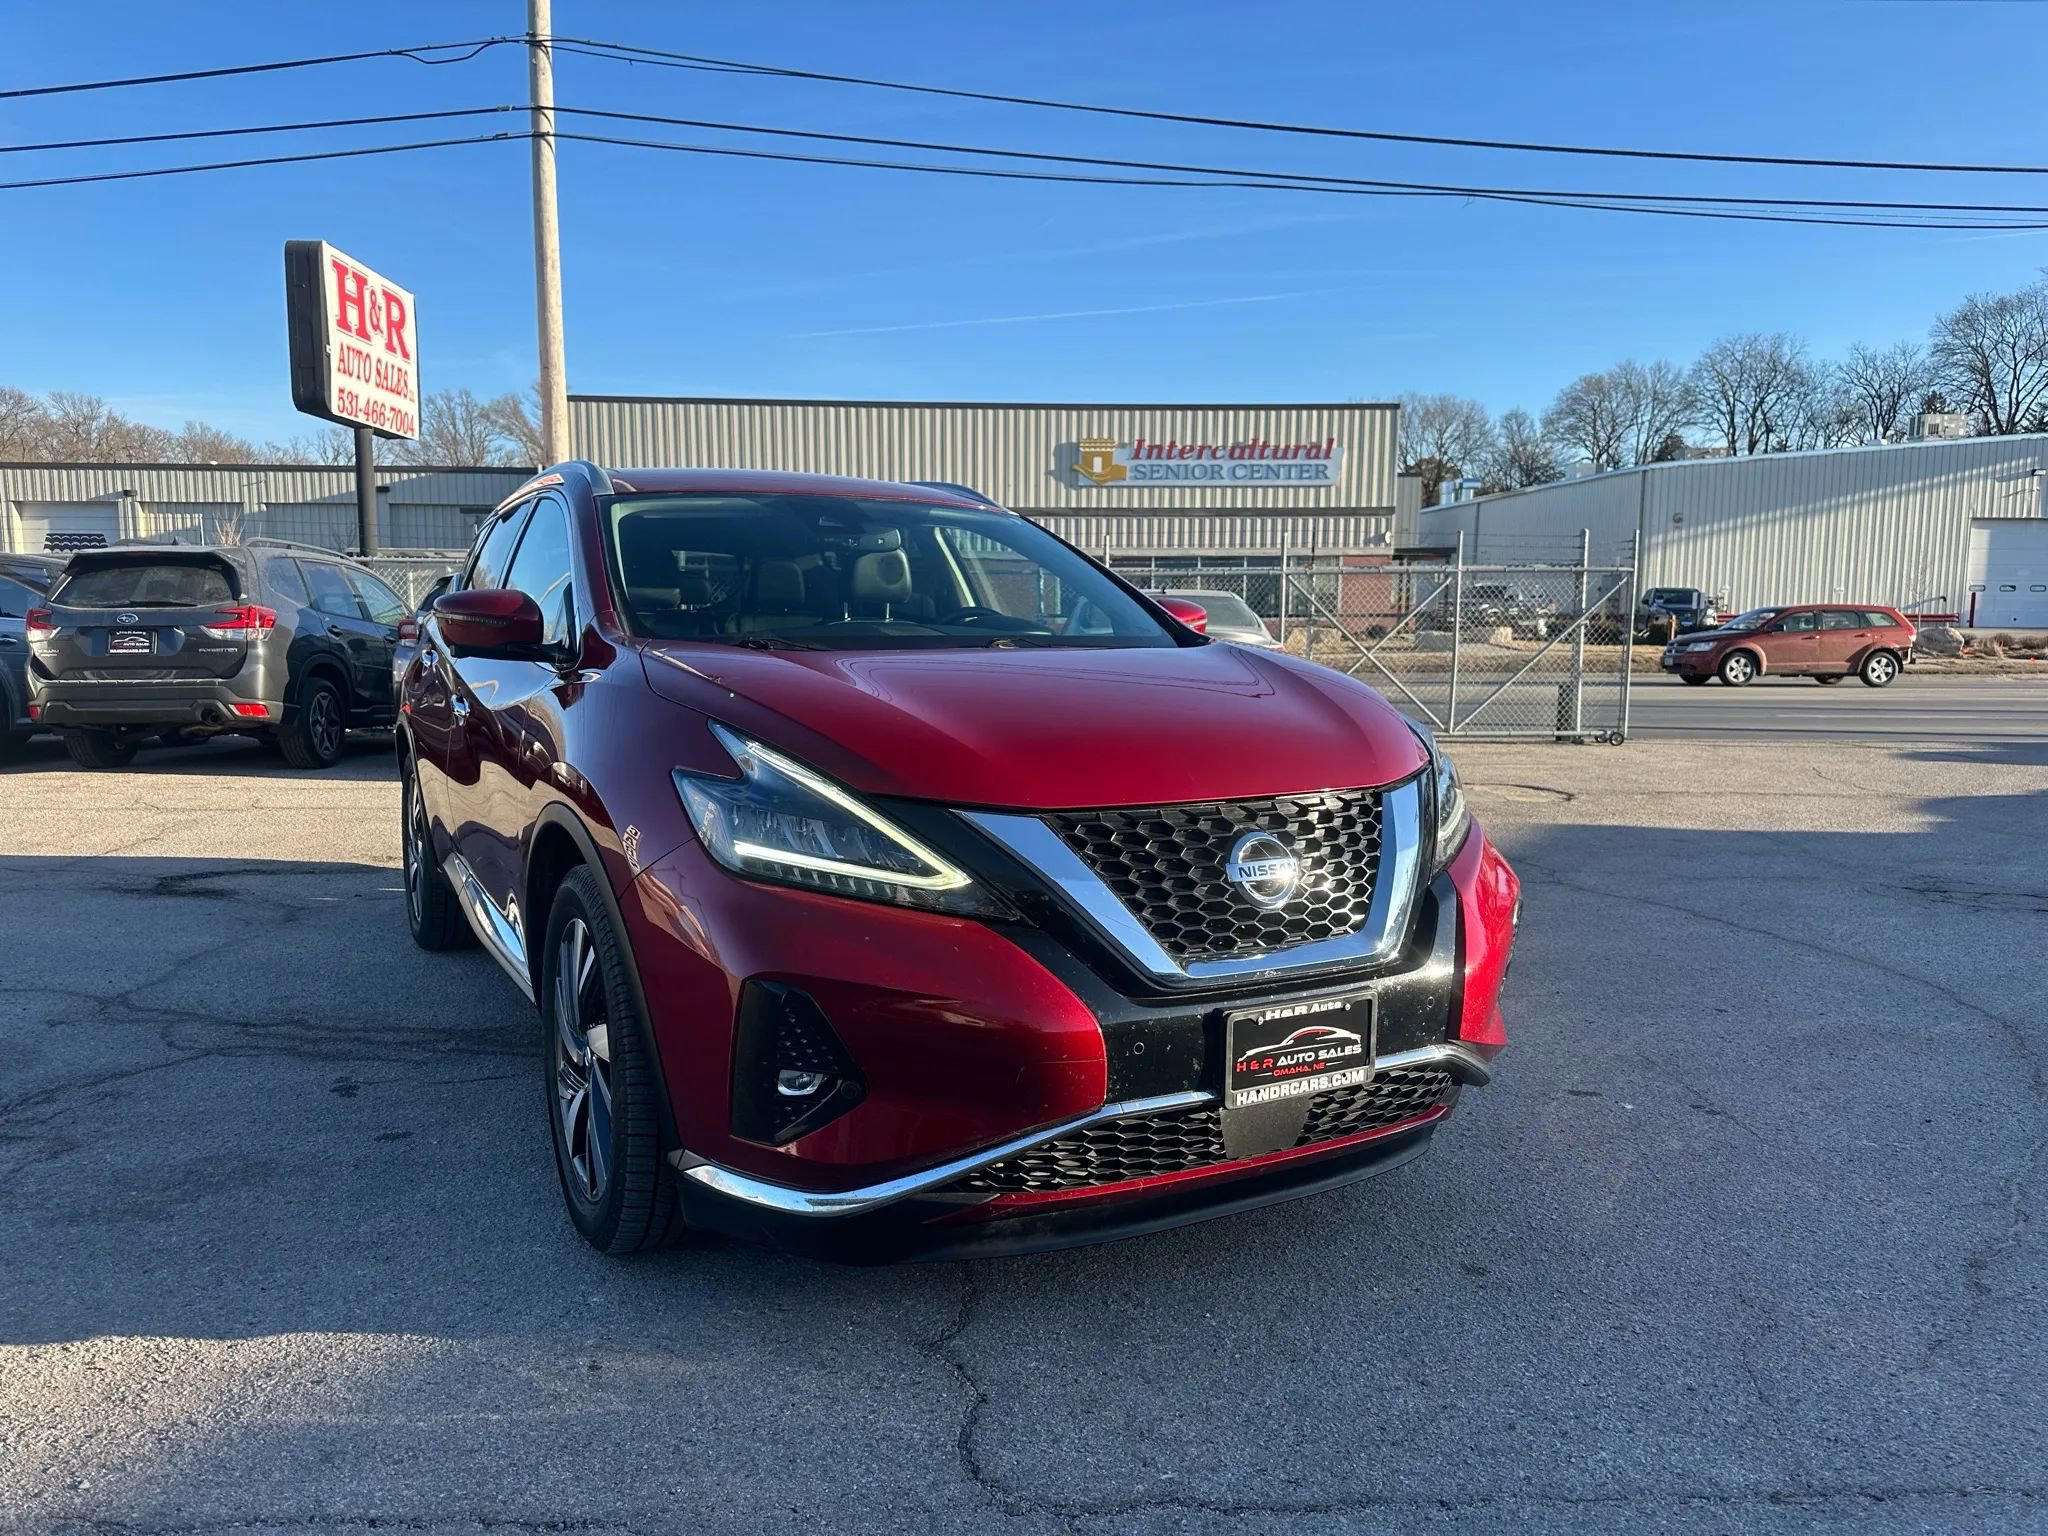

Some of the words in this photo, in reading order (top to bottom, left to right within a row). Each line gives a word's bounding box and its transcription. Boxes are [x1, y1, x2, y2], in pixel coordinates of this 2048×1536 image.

[331, 258, 411, 361] H&R
[338, 343, 372, 384] AUTO
[375, 360, 409, 398] SALES
[337, 388, 415, 437] 531-466-7004
[1131, 437, 1335, 461] Intercultural
[1133, 463, 1226, 481] SENIOR
[1232, 463, 1329, 480] CENTER
[1236, 1062, 1247, 1073] H
[1263, 1058, 1274, 1069] R
[1277, 1053, 1316, 1067] AUTO
[1317, 1044, 1362, 1060] SALES
[1313, 1062, 1326, 1071] NE
[1236, 1069, 1365, 1106] HANDRCARS.COM
